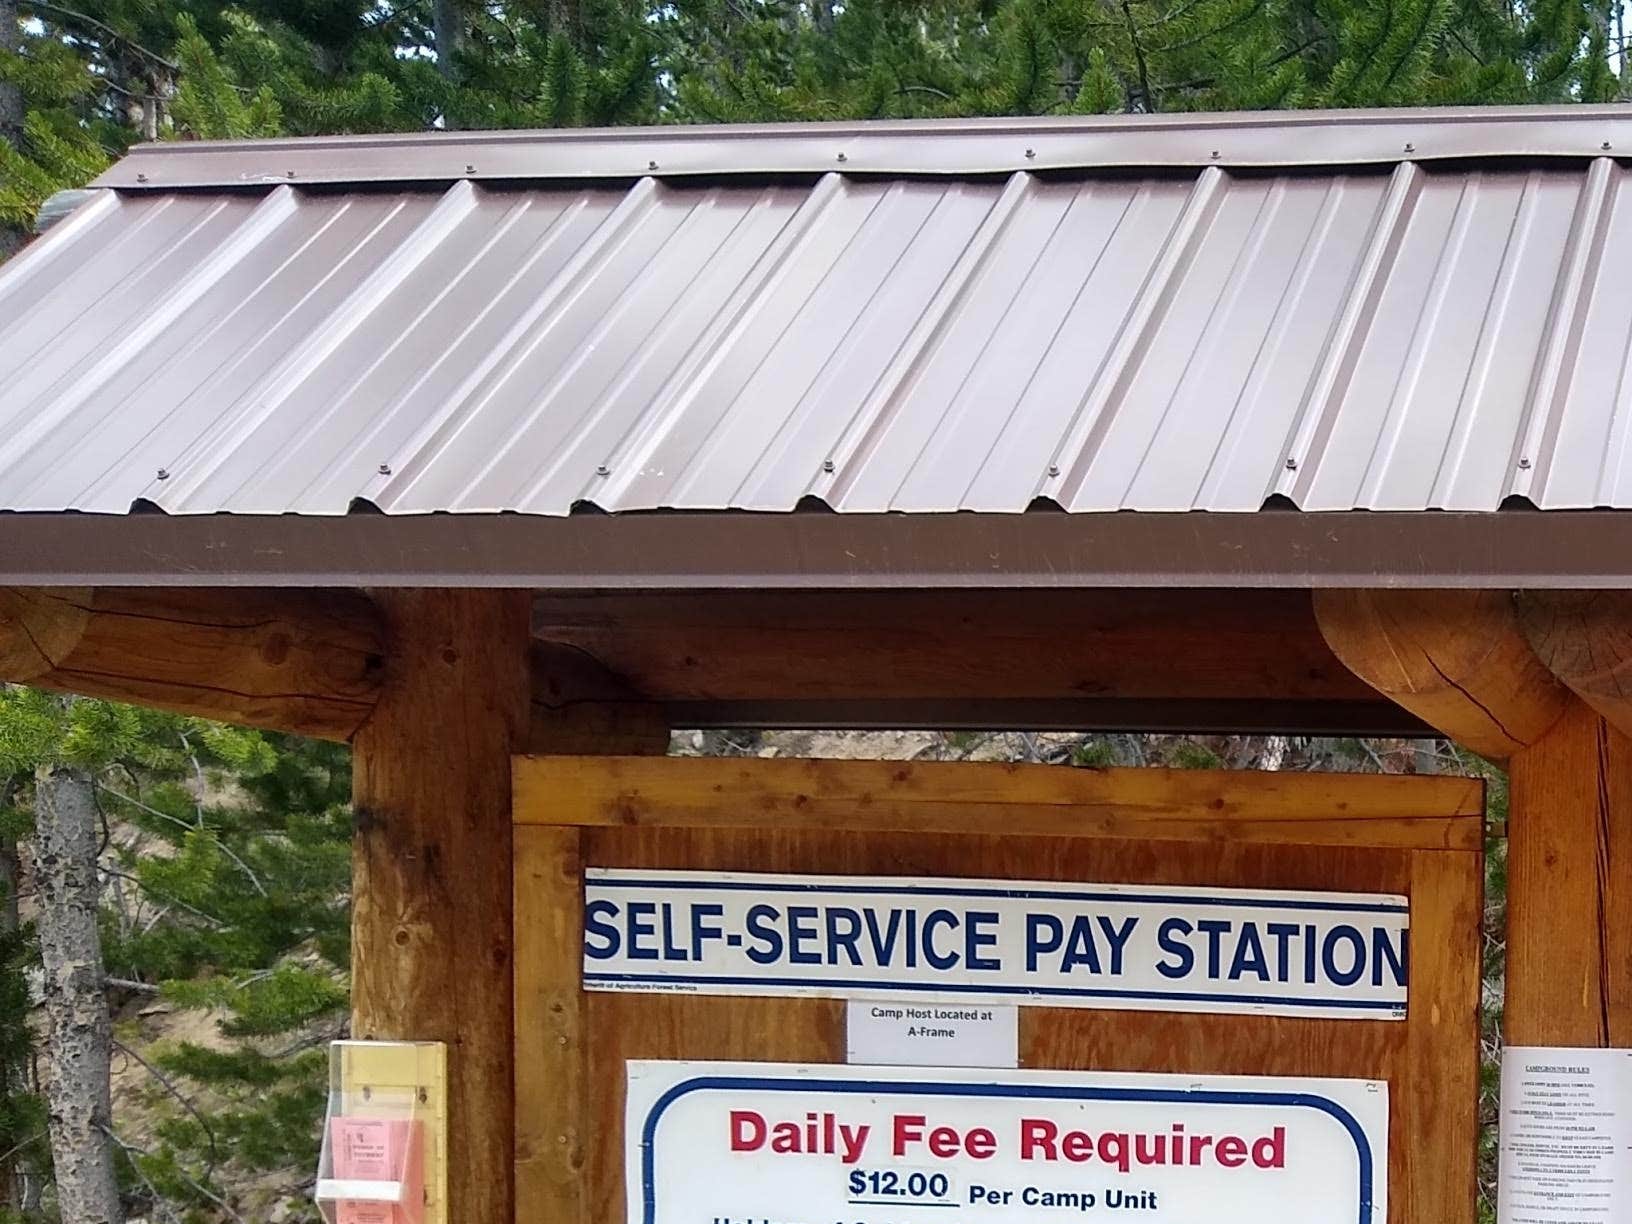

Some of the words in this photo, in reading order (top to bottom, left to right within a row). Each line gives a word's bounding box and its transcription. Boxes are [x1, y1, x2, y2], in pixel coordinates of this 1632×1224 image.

[585, 899, 1001, 970] SELF-SERVICE
[1026, 914, 1139, 975] PAY
[1156, 918, 1408, 987] STATION
[872, 1008, 903, 1020] Camp
[907, 1009, 931, 1018] Host
[935, 1010, 977, 1020] Located
[980, 1010, 992, 1020] at
[908, 1027, 954, 1037] A-Frame
[730, 1111, 870, 1163] Daily
[893, 1115, 996, 1159] Fee
[1021, 1119, 1285, 1173] Required
[849, 1169, 948, 1197] $12.00
[970, 1186, 1013, 1204] Per
[1023, 1187, 1095, 1211] Camp
[1106, 1190, 1156, 1209] Unit
